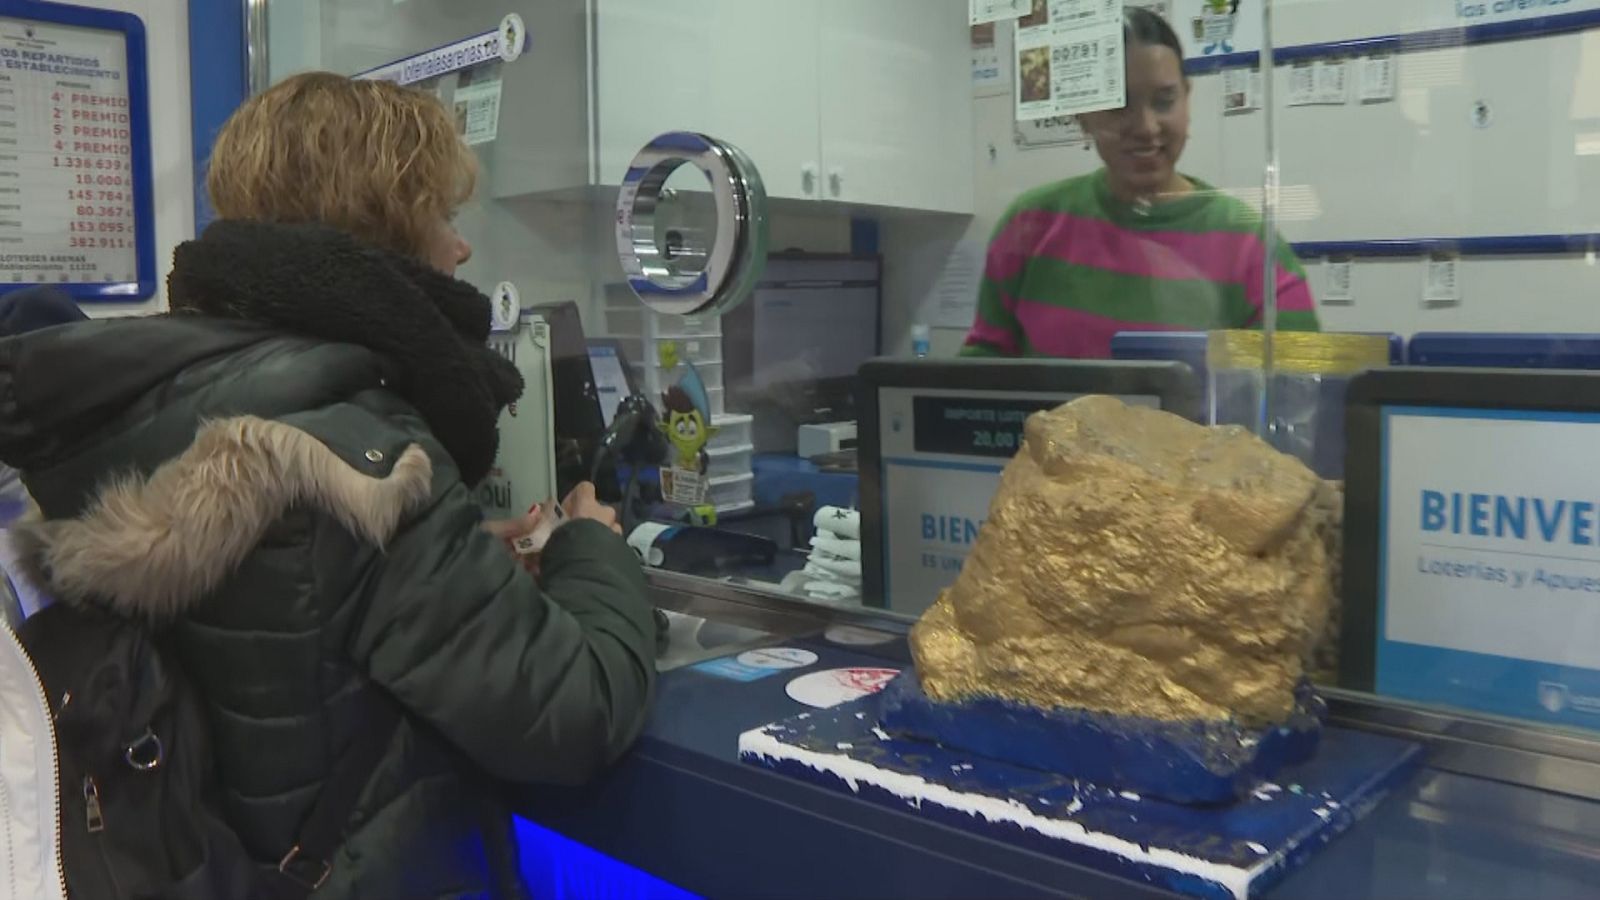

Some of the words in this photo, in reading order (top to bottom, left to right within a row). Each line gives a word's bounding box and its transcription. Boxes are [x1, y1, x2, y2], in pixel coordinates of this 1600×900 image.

[71, 93, 127, 108] PREMIO
[72, 109, 128, 123] PREMIO
[73, 125, 129, 139] PREMIO
[74, 141, 130, 155] PREMIO
[1419, 488, 1600, 546] BIENVE
[1511, 570, 1527, 588] y
